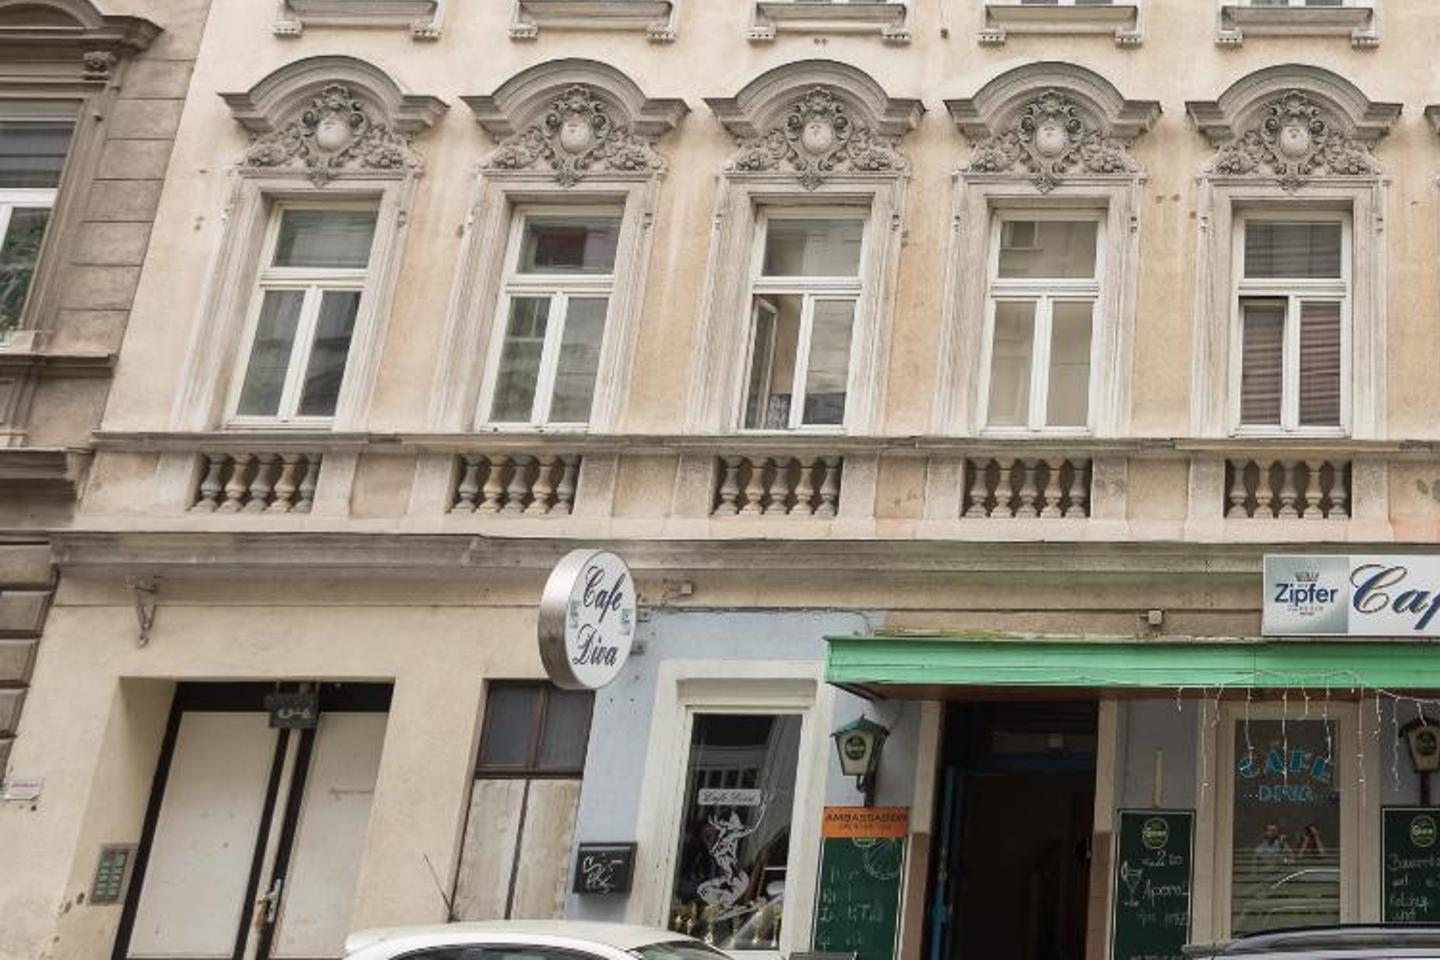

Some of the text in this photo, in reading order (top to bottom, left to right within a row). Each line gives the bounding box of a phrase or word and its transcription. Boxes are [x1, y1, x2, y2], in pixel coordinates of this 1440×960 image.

[583, 565, 626, 623] Cafe
[1274, 582, 1340, 607] Zipfer
[572, 623, 618, 667] Diva
